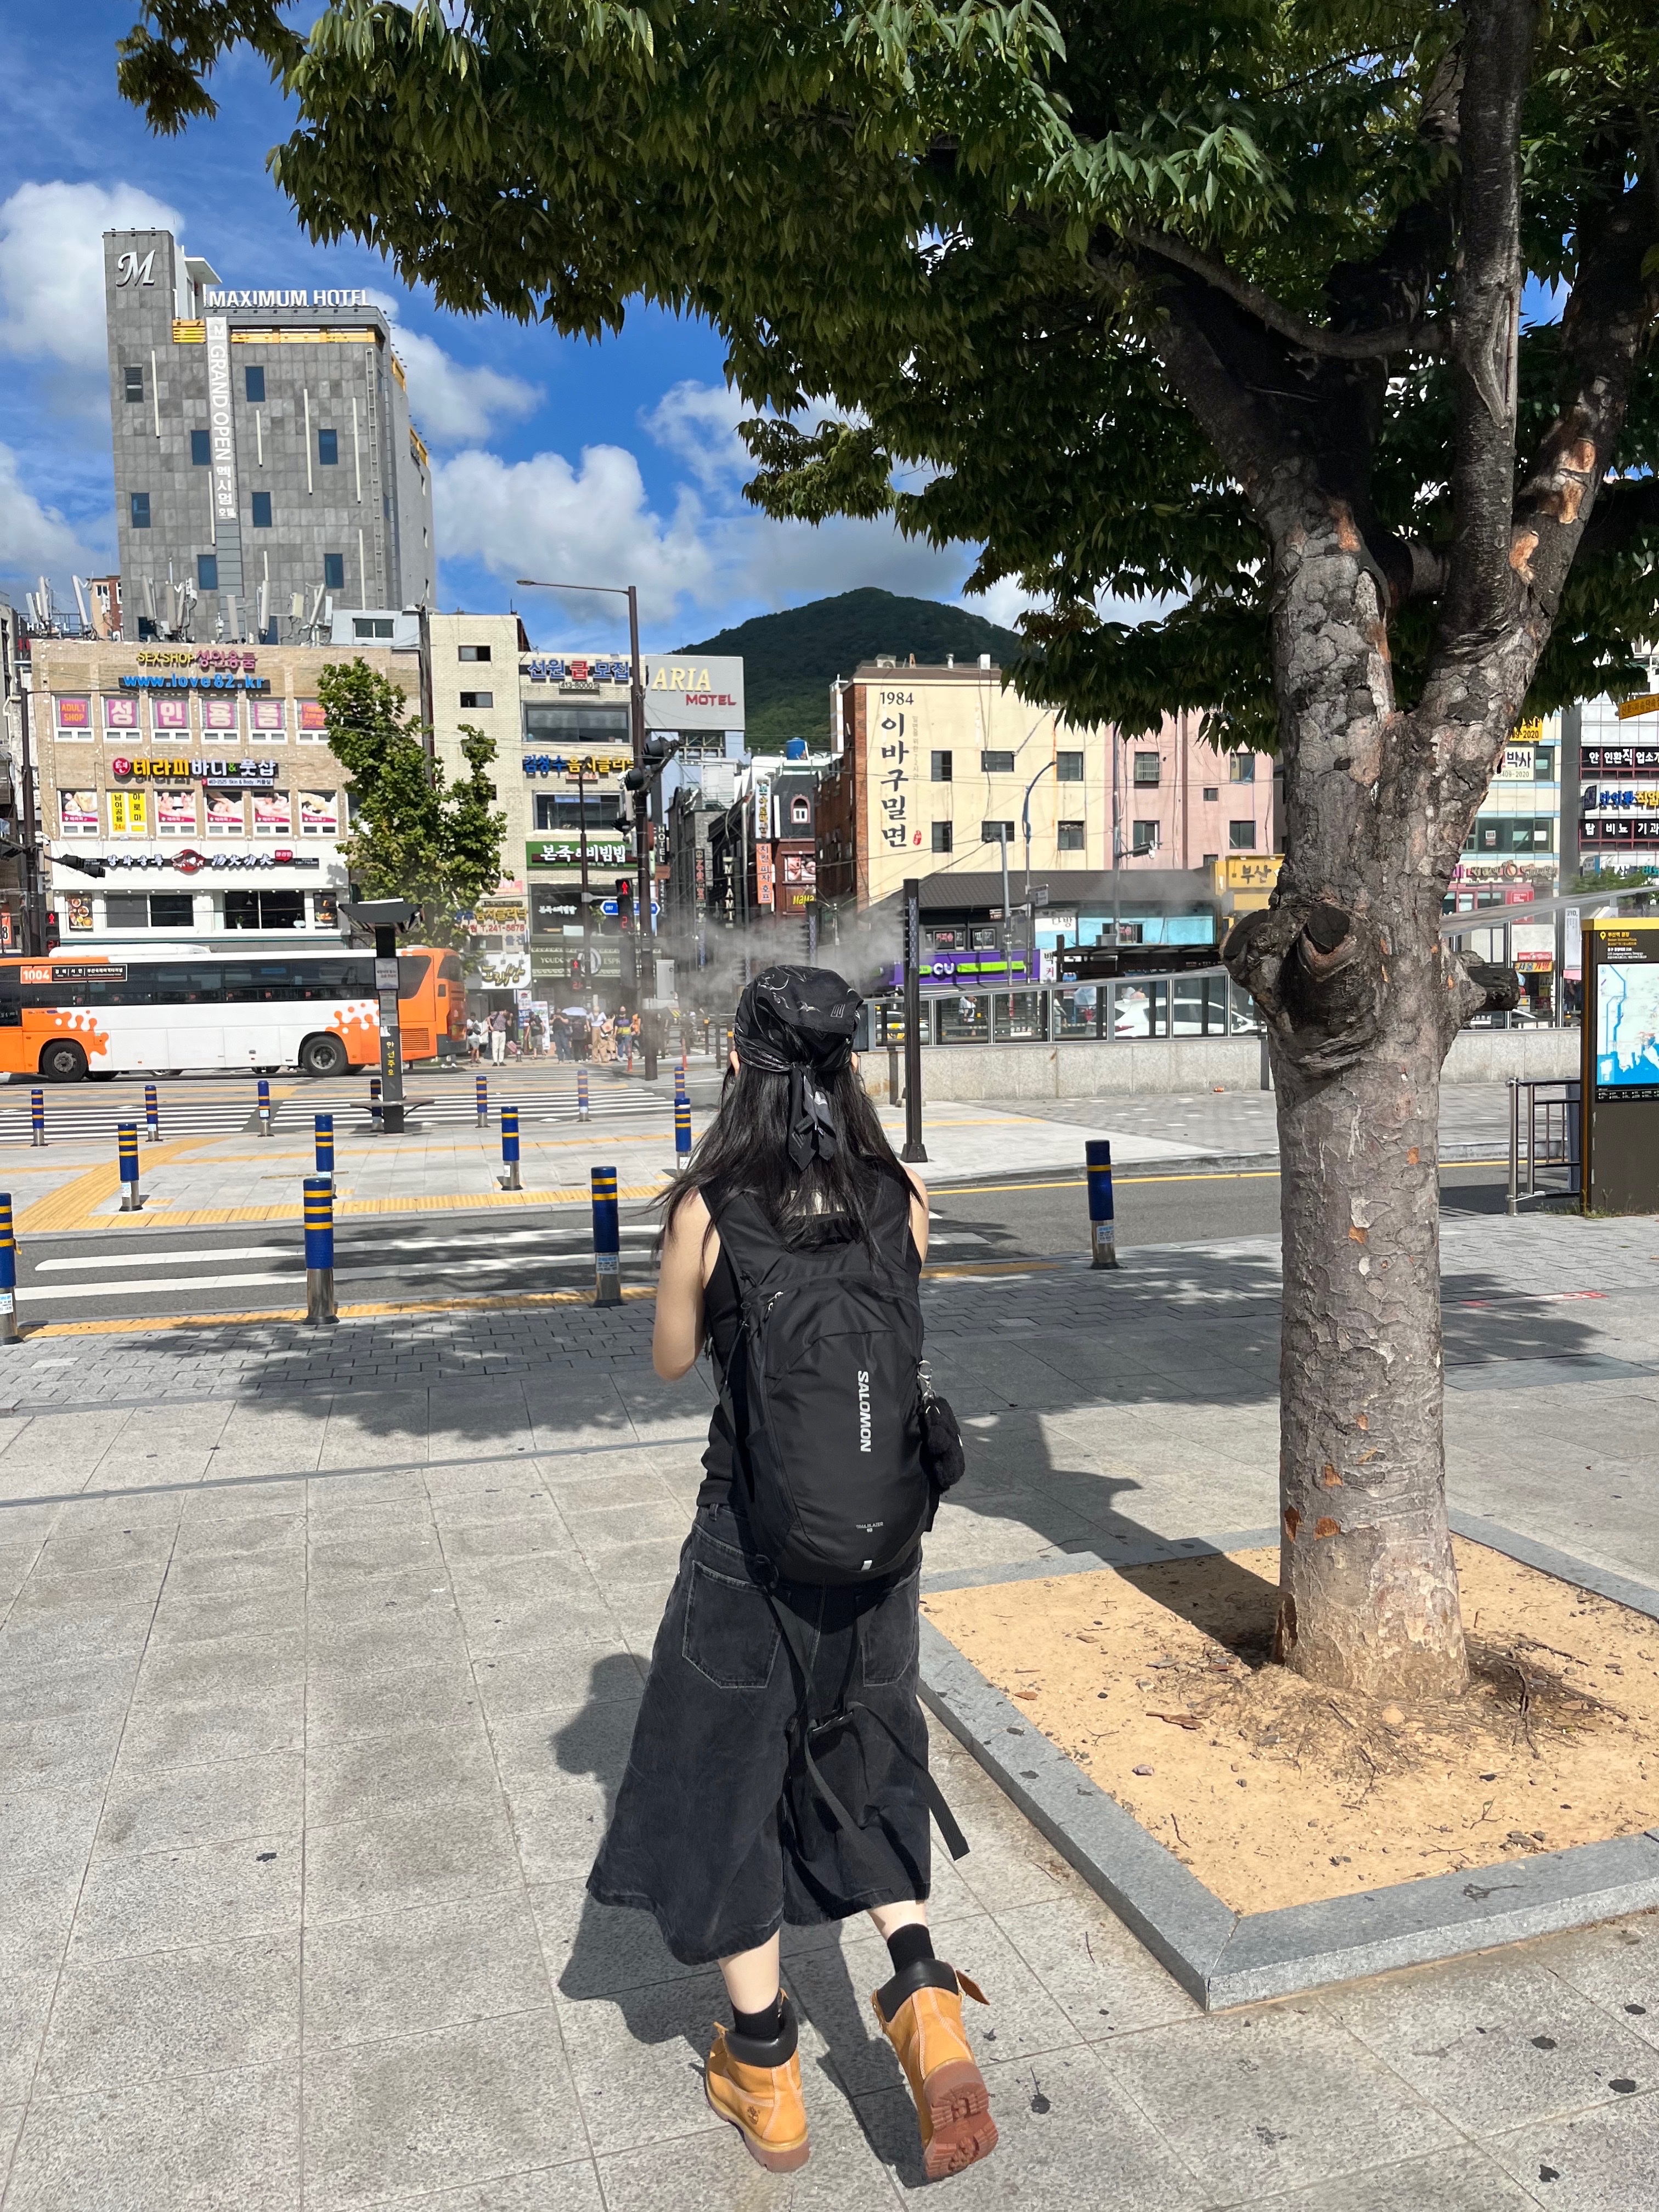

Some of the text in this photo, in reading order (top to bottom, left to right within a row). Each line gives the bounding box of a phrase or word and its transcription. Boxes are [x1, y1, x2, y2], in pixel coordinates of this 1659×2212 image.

[116, 250, 155, 286] M
[210, 290, 371, 307] MAXIMUM HOTEL
[210, 345, 232, 460] GRAND OPEN
[197, 650, 256, 669] 성인용품
[527, 658, 629, 680] 선원 급 모집
[123, 673, 264, 689] www.love82.kr
[651, 667, 712, 691] ARIA
[686, 693, 737, 707] MOTEL
[879, 691, 915, 706] 1984
[61, 703, 86, 712] ADULT
[64, 713, 84, 722] SHOP
[880, 712, 910, 848] 이바구밀면
[760, 845, 769, 863] 치킨
[760, 865, 770, 882] 피자
[1241, 864, 1272, 884] 부산
[724, 865, 733, 921] MIAMI
[761, 884, 771, 901] 호프
[22, 969, 50, 980] 1004
[933, 962, 955, 975] CU
[857, 1370, 872, 1452] SALOMON
